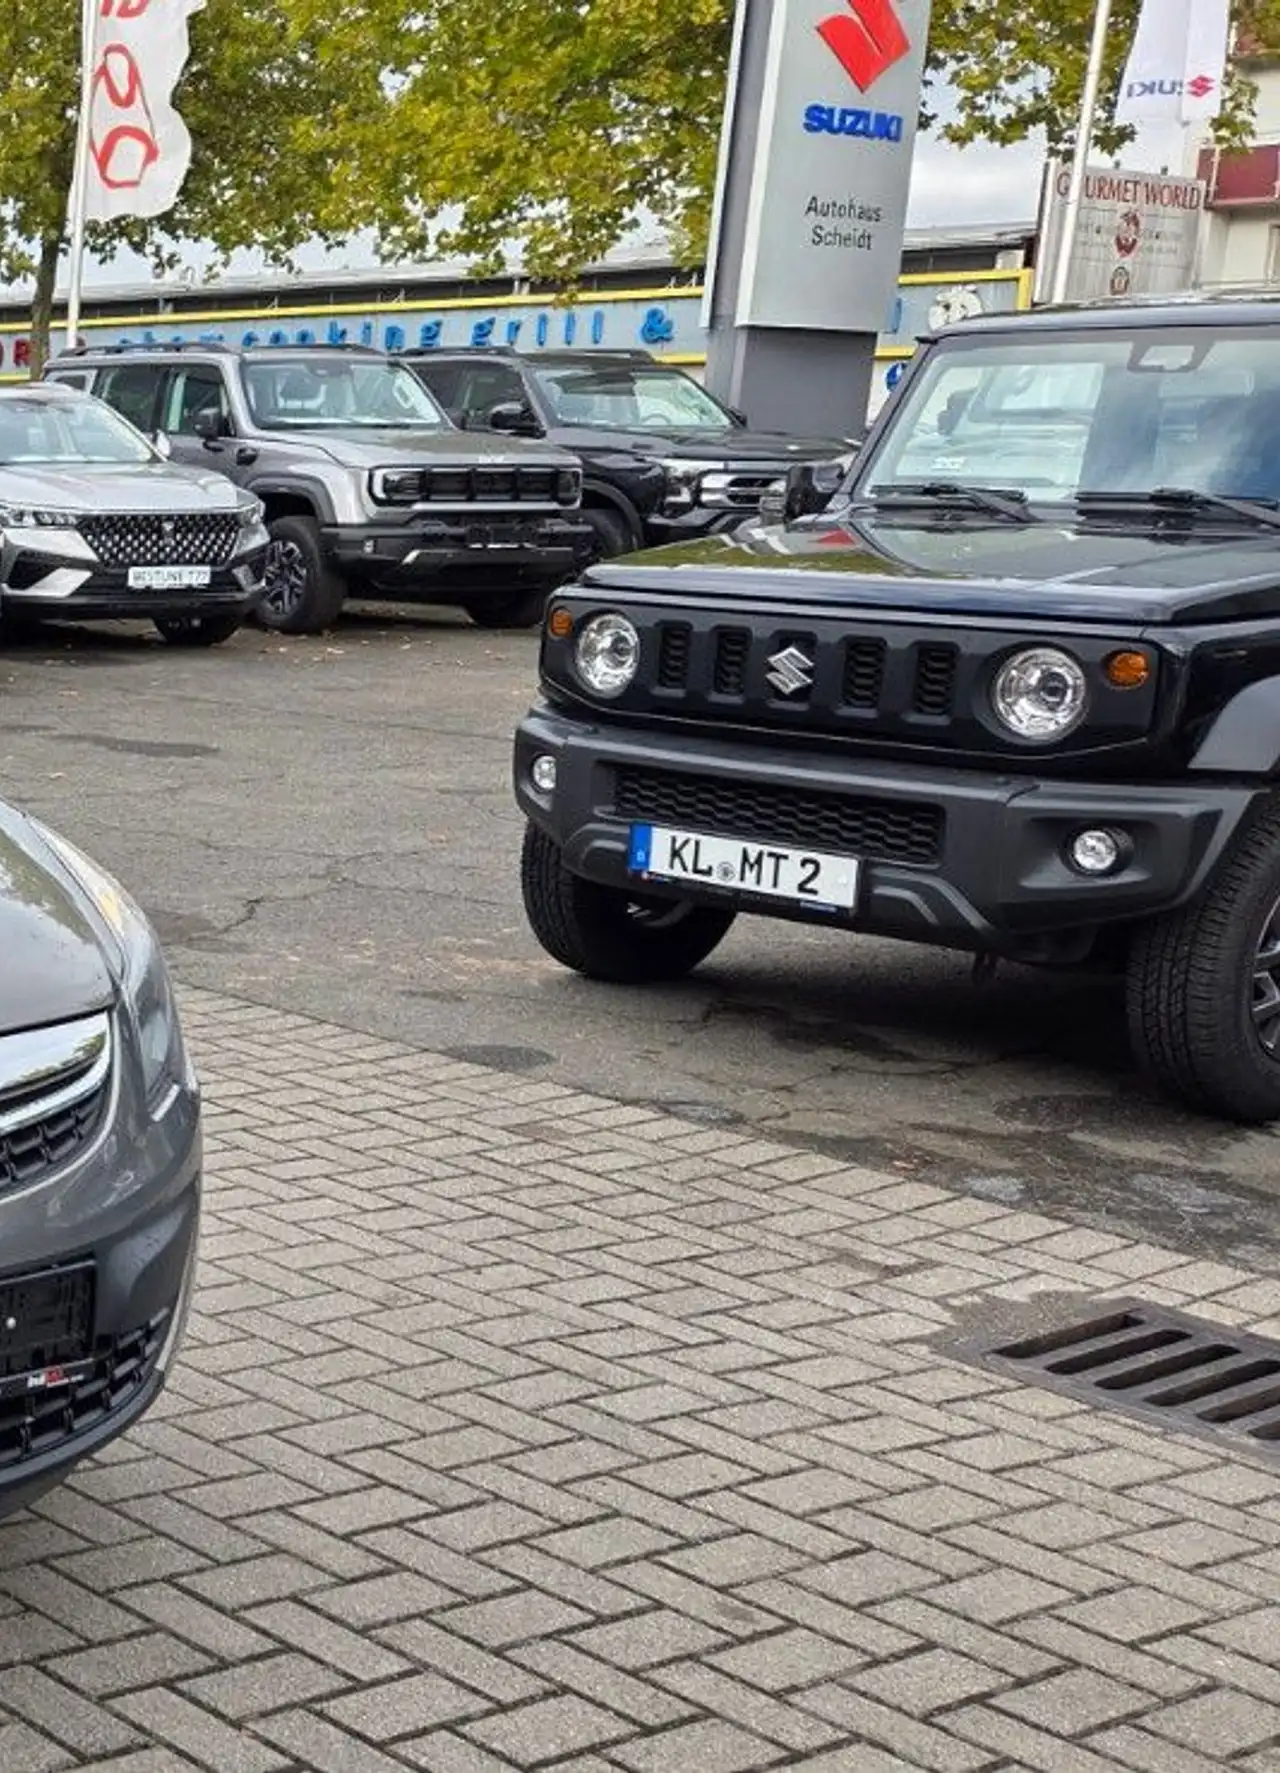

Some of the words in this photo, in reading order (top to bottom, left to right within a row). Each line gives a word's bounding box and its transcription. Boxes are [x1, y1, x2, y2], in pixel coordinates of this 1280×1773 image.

[803, 103, 904, 143] SUZUKI
[805, 196, 883, 222] Autohaus
[1057, 172, 1140, 203] GURMET
[1144, 182, 1202, 210] WORLD
[812, 224, 873, 250] Scheidt
[472, 309, 604, 347] grill
[640, 308, 674, 345] &
[668, 835, 713, 877] KL
[740, 847, 789, 889] MT
[797, 857, 822, 896] 2
